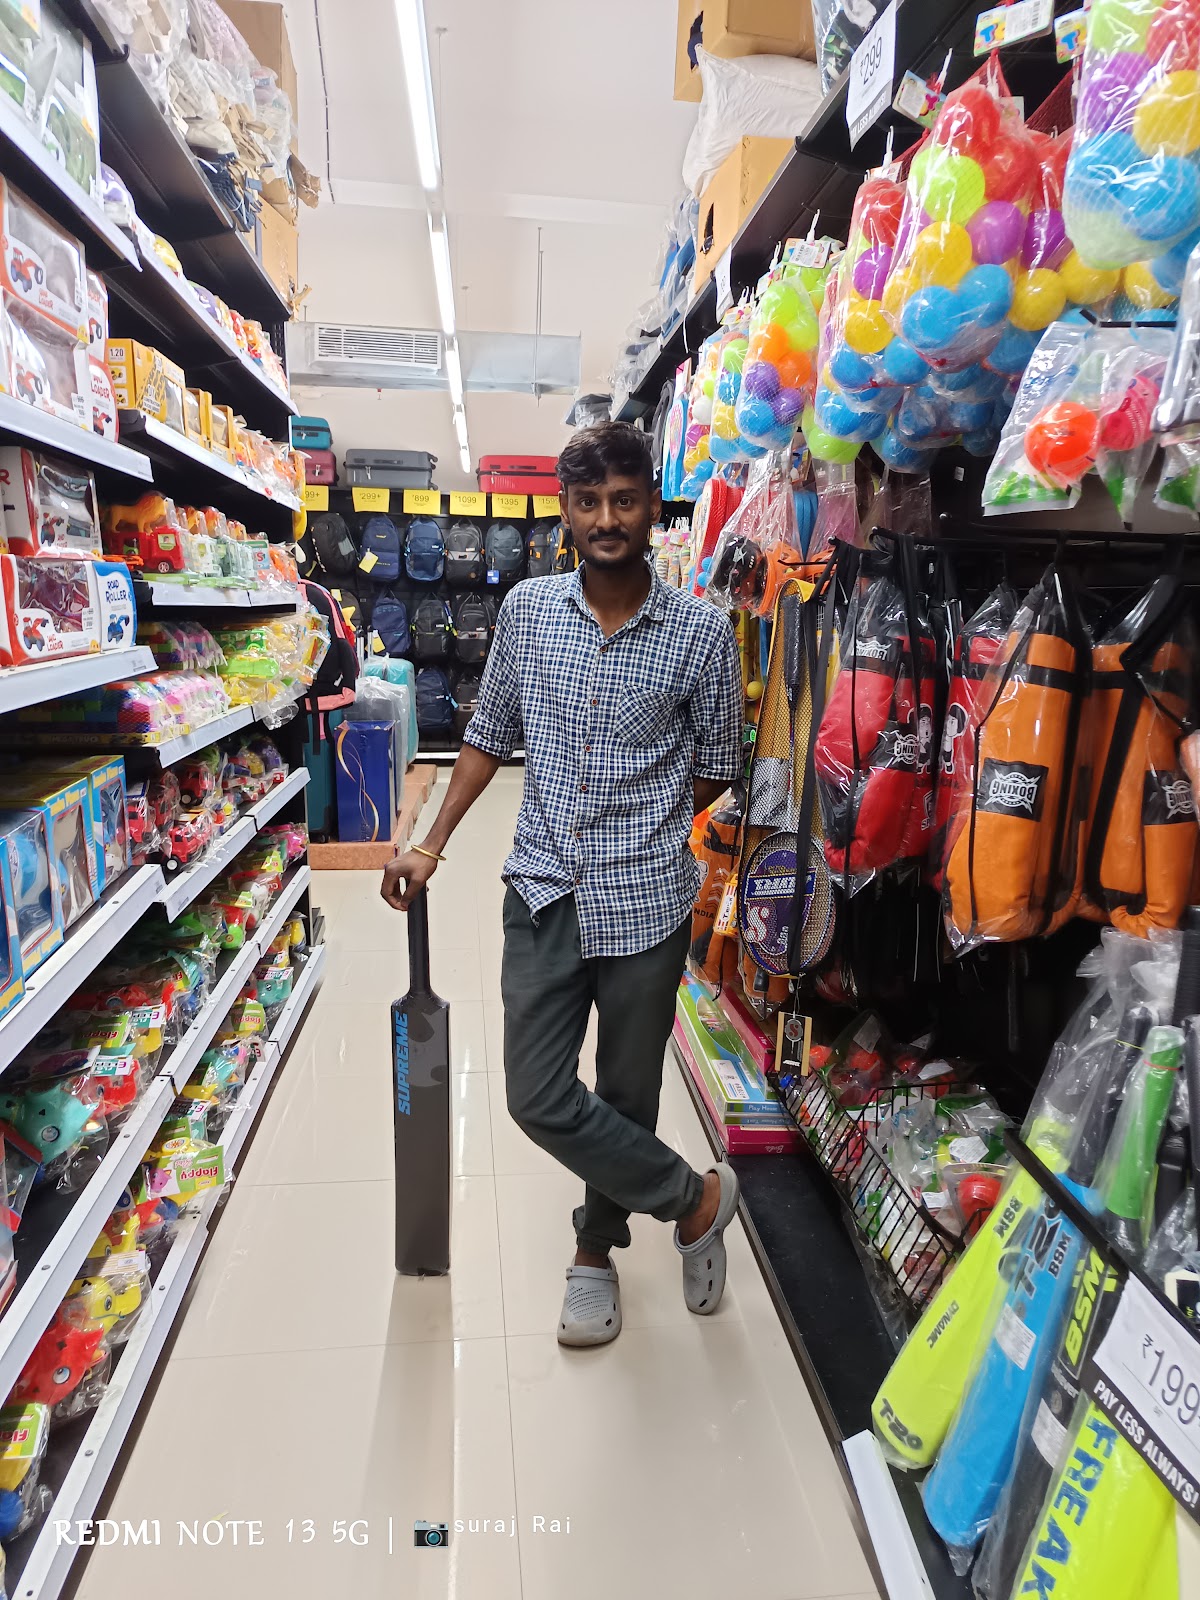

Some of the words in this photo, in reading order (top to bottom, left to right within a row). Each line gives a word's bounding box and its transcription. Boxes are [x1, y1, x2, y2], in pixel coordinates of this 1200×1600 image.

[110, 348, 124, 357] 1.20
[305, 490, 320, 499] 99+
[105, 589, 128, 604] ROLLER
[991, 780, 1036, 804] BOXING
[693, 907, 715, 919] NDIA
[395, 1010, 411, 1116] SUPREME
[179, 1166, 219, 1181] Flappy
[993, 1195, 1023, 1239] BSM
[1047, 1230, 1072, 1279] BSM
[926, 1300, 960, 1349] DYNAMIC
[1064, 1246, 1106, 1367] BSM
[1142, 1333, 1200, 1426] ₹199
[1093, 1379, 1120, 1411] PAY
[1114, 1404, 1146, 1446] LESS
[1141, 1438, 1200, 1509] ALWAYS!
[1021, 1415, 1120, 1600] FREAK
